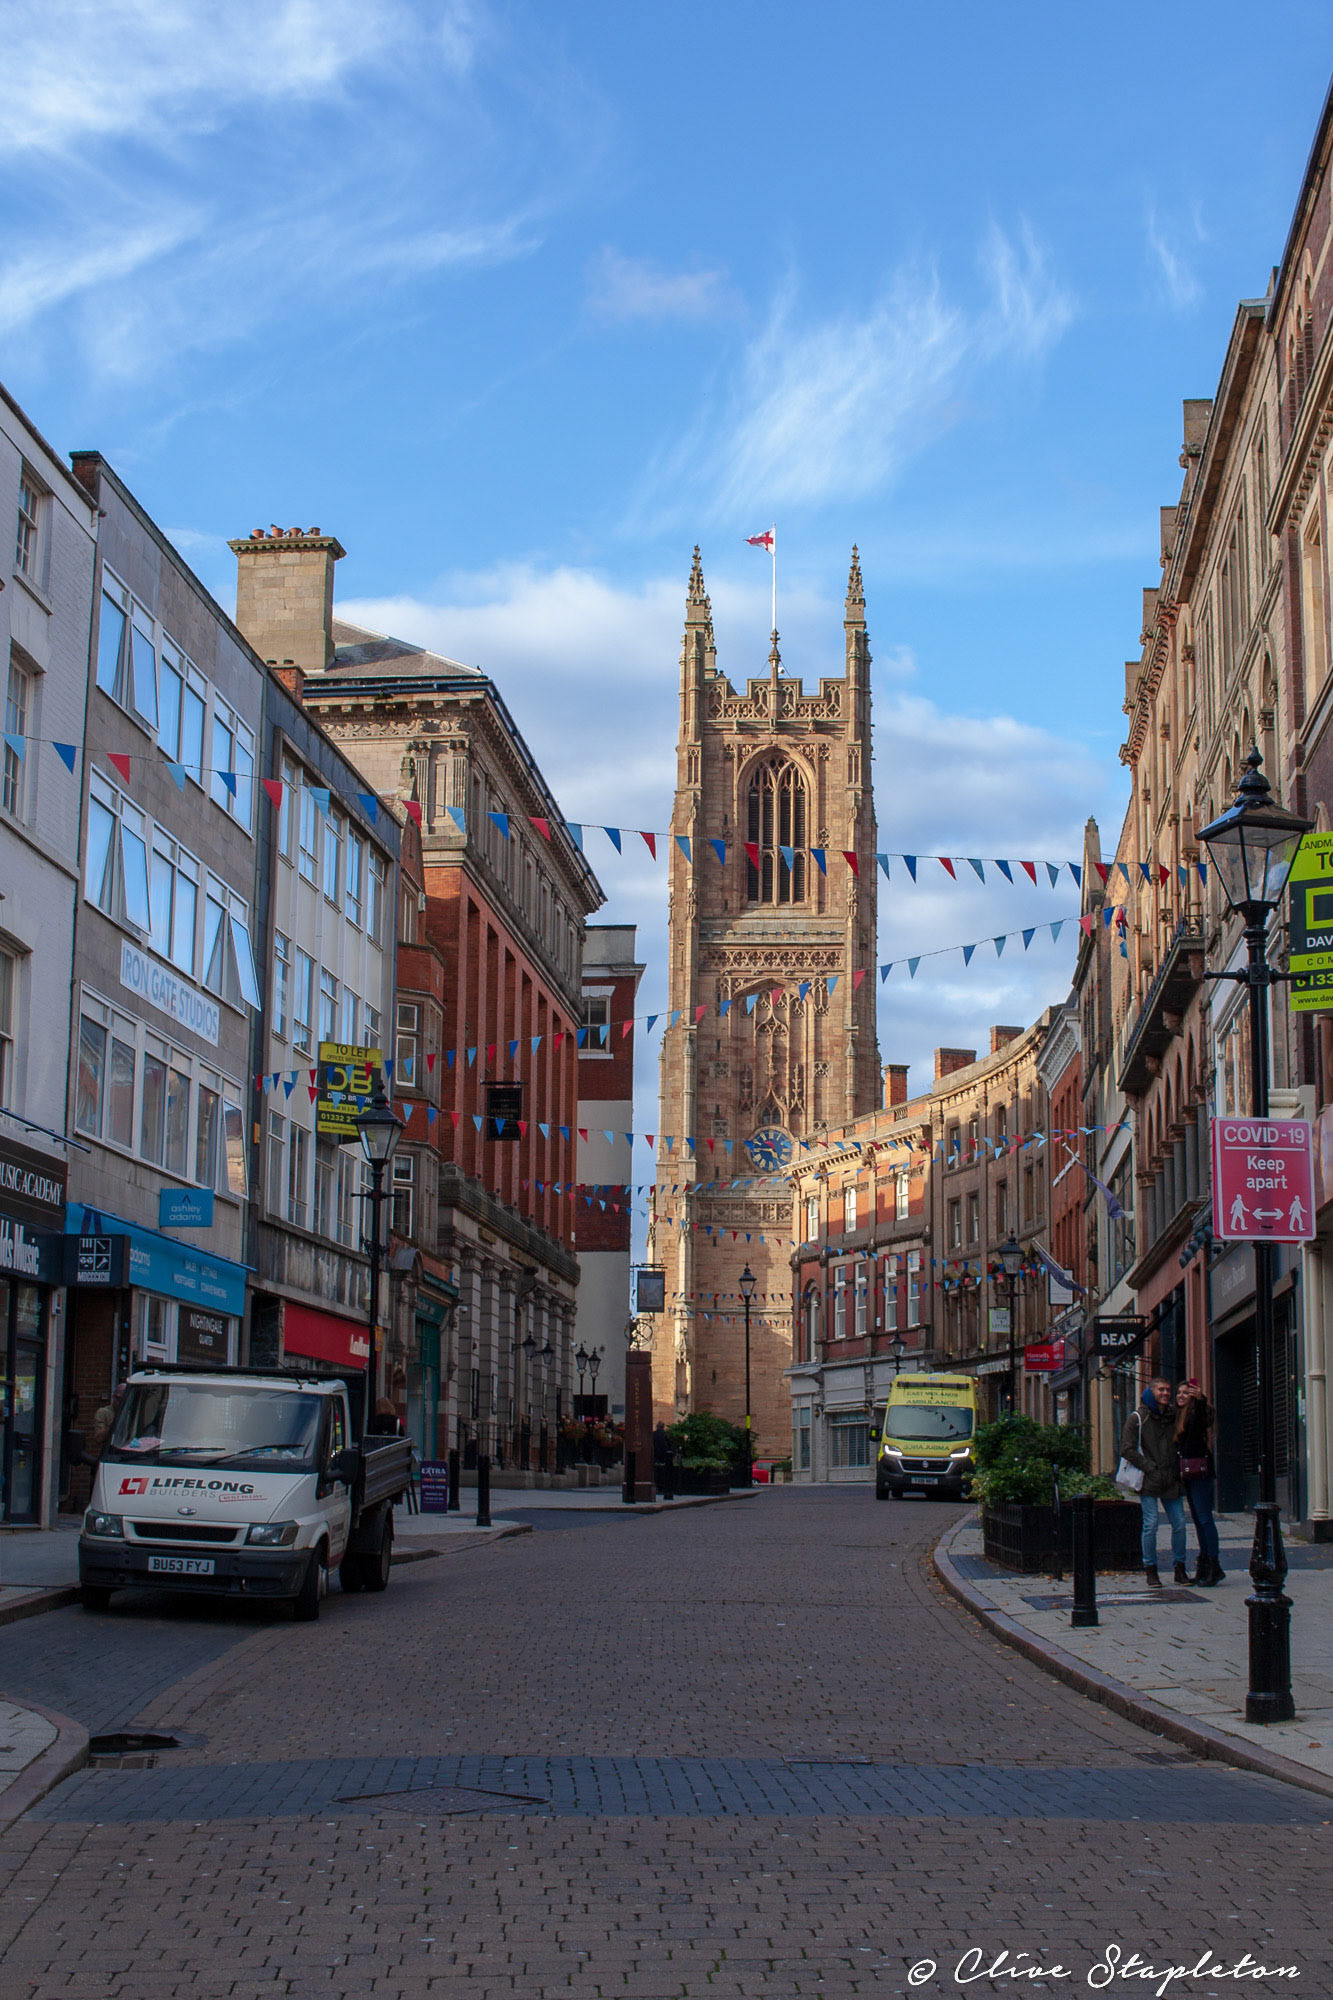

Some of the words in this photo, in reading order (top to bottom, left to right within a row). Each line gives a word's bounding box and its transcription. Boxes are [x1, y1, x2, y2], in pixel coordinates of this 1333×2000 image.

[122, 946, 149, 994] IRON
[151, 968, 177, 1013] GATE
[179, 987, 218, 1040] STUDIOS
[335, 1043, 348, 1056] TO
[351, 1046, 370, 1058] LET
[321, 1112, 344, 1122] 01332
[1224, 1126, 1305, 1144] COVID-19
[1246, 1155, 1285, 1174] Keep
[0, 1162, 22, 1191] USIC
[21, 1171, 63, 1206] ACADEMY
[1246, 1174, 1288, 1192] apart
[171, 1203, 202, 1213] ashley
[169, 1212, 202, 1221] adams
[13, 1223, 40, 1275] Music
[190, 1312, 223, 1335] NIGHTINGALE
[906, 1399, 959, 1407] AMBULANCE
[421, 1466, 446, 1477] EXTRA
[150, 1488, 217, 1499] BUILDERS
[152, 1477, 255, 1494] LIFELONG
[153, 1558, 184, 1571] BU53
[186, 1560, 210, 1573] FYJ
